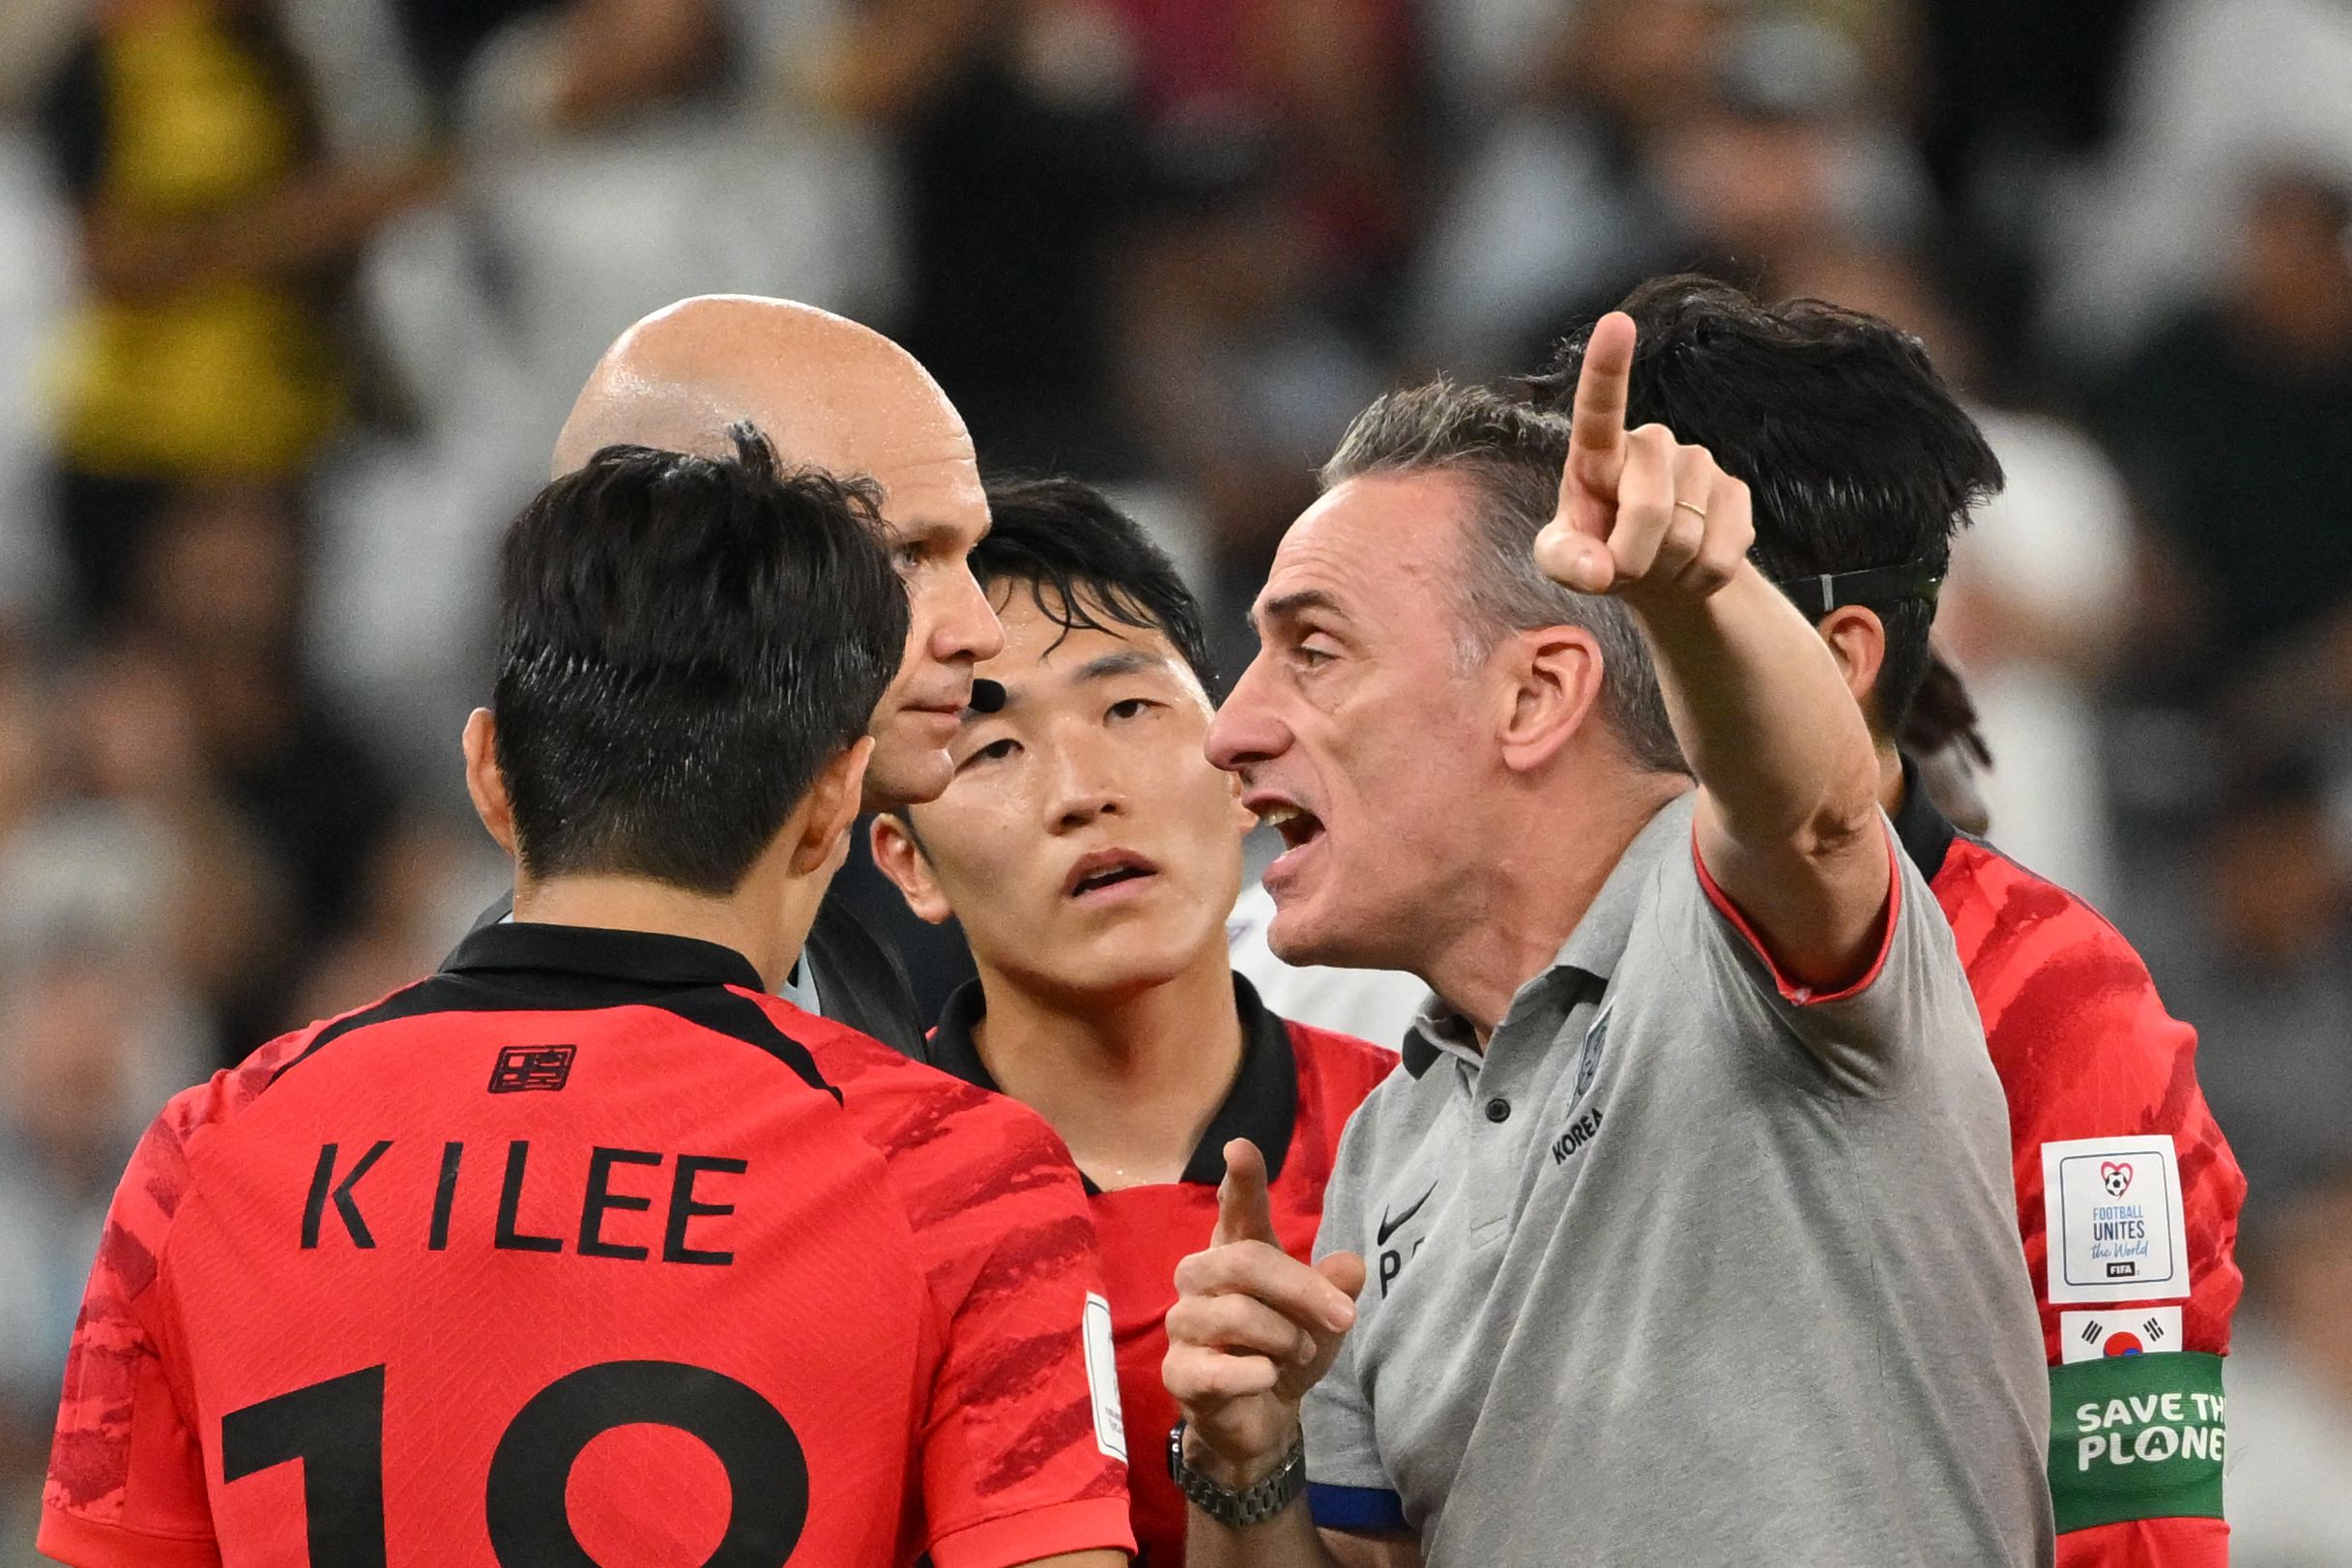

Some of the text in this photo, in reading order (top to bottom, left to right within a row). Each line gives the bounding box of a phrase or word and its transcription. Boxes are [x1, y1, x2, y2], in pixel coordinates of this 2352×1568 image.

[1552, 1107, 1603, 1165] KOREA
[2093, 1205, 2143, 1221] FOOTBALL
[2093, 1220, 2145, 1241] UNITES
[2091, 1240, 2149, 1259] the World
[2109, 1264, 2134, 1275] FIFA
[2076, 1393, 2226, 1433] SAVE TH
[2078, 1425, 2226, 1471] PLANE
